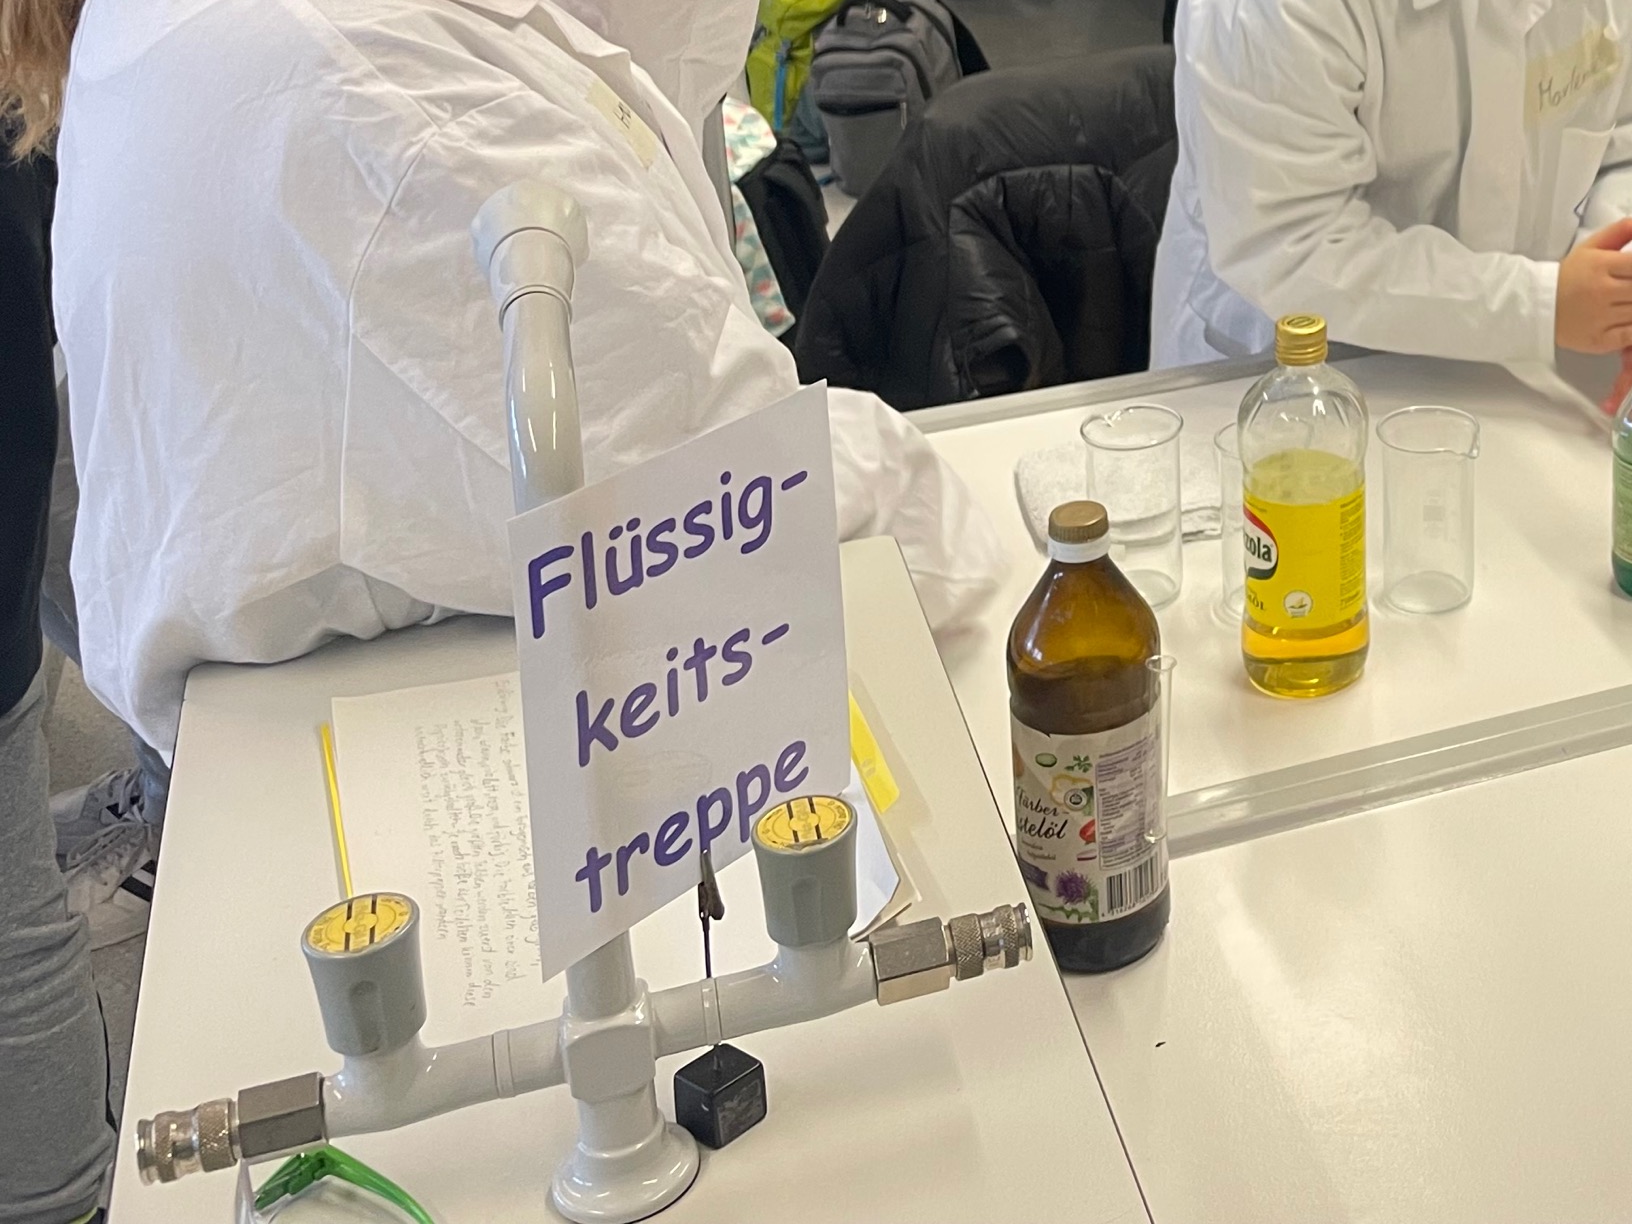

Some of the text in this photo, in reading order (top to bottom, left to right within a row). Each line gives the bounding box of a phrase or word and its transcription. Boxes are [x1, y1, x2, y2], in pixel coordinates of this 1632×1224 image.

[528, 470, 808, 640] Flüssig-
[576, 623, 790, 768] keits-
[575, 740, 809, 914] treppe
